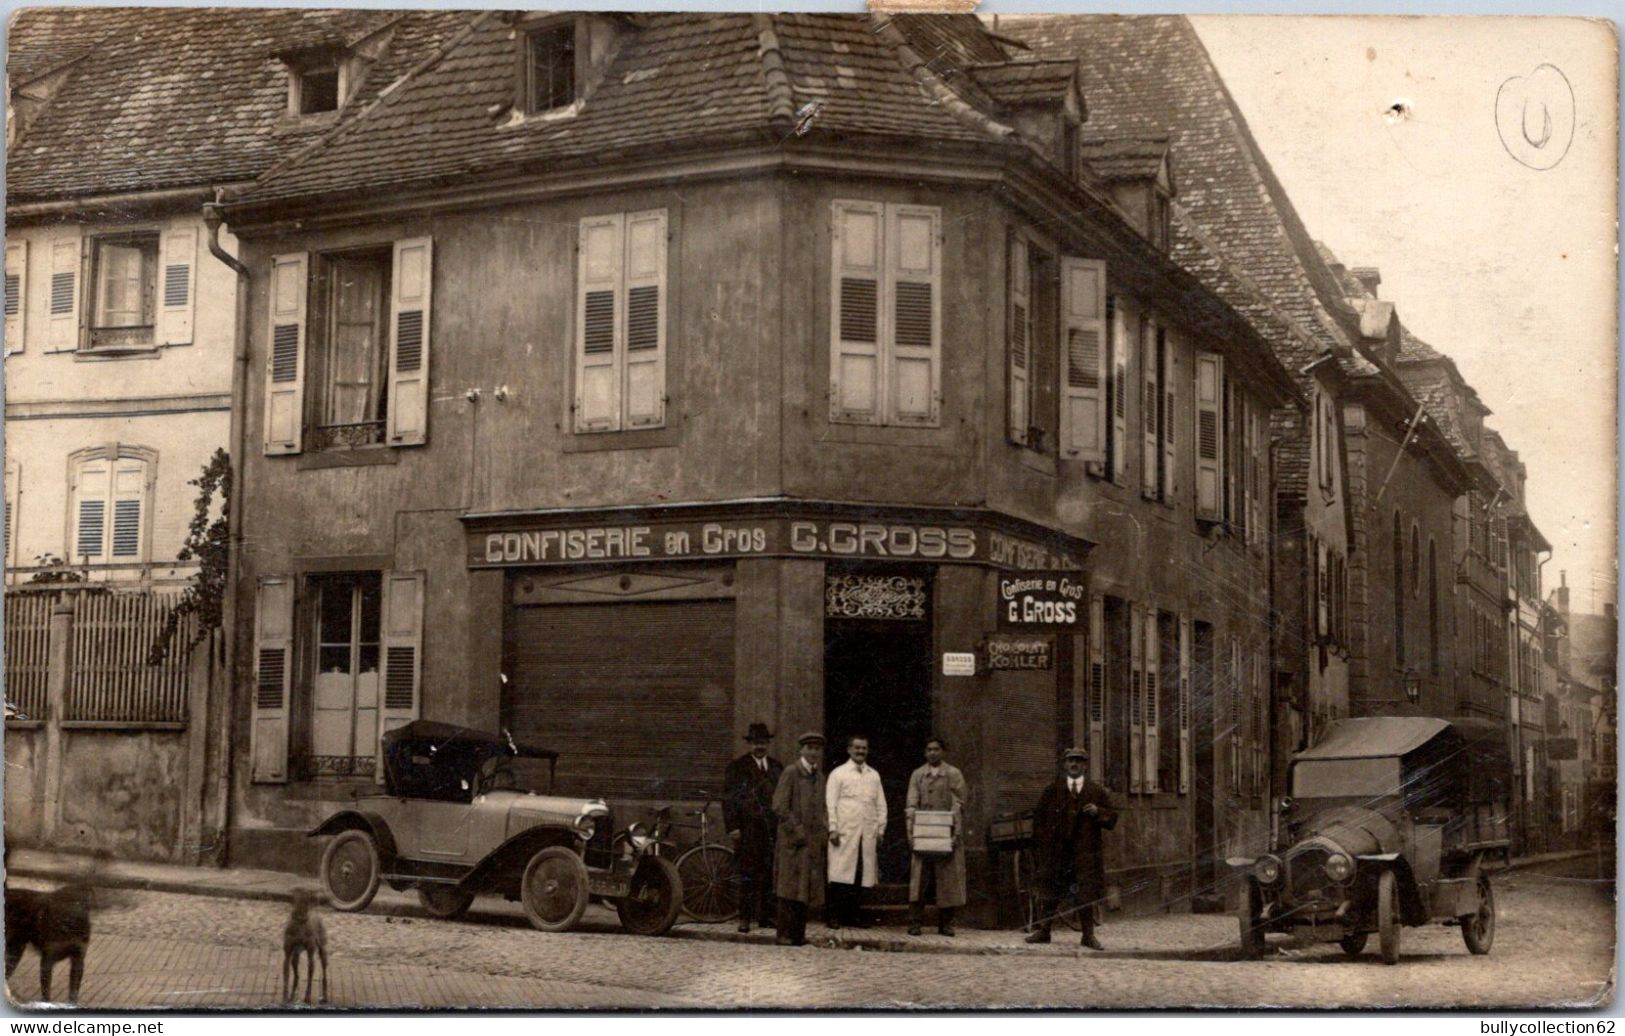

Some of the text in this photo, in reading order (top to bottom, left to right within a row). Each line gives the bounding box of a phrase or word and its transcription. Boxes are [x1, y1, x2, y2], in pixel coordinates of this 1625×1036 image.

[486, 523, 766, 562] CONFISERIE en Gros
